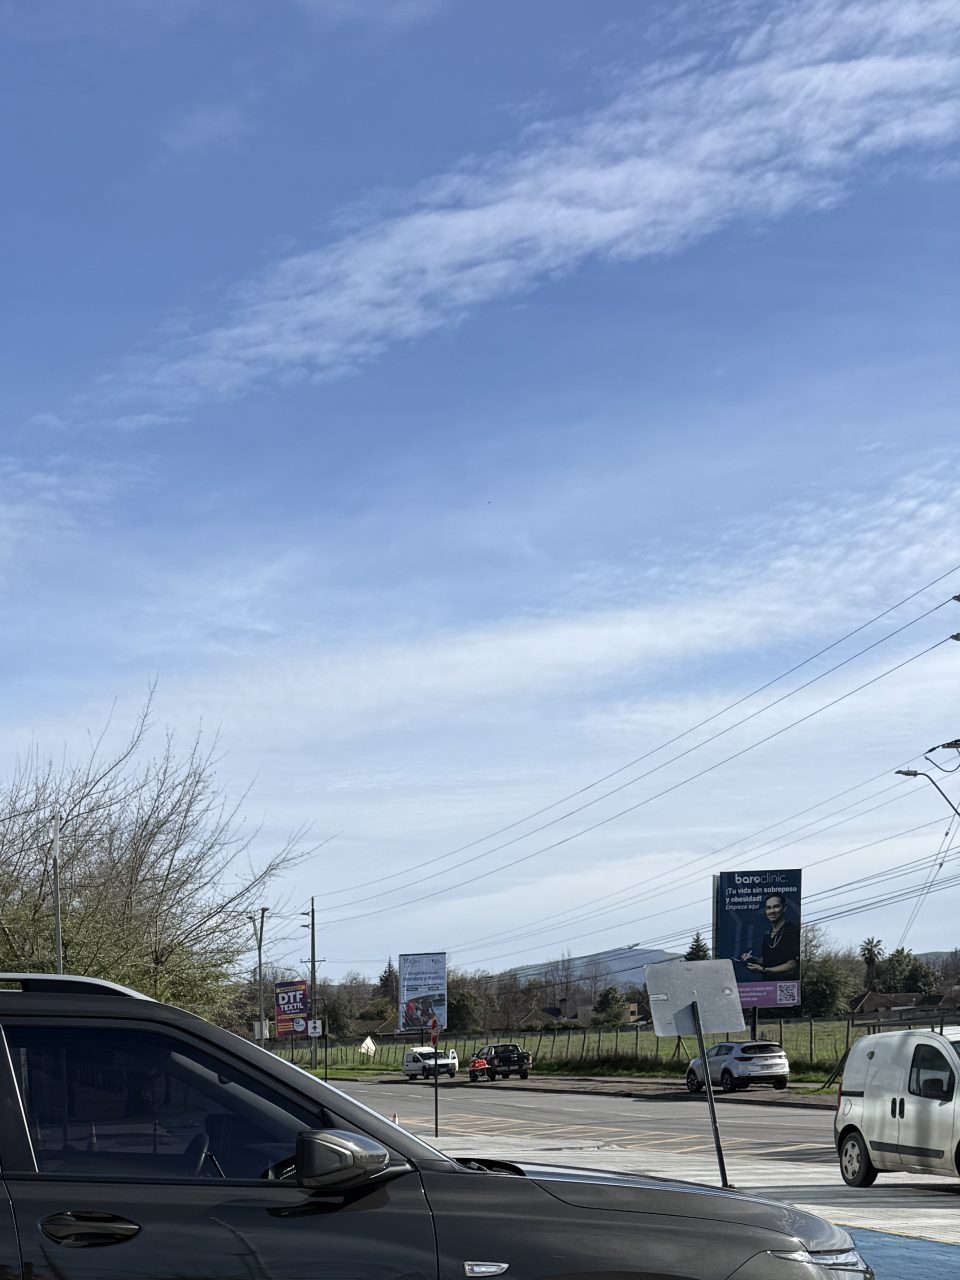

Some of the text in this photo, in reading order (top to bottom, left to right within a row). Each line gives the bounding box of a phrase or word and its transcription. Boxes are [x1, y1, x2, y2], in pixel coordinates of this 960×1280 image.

[738, 886, 751, 894] vida
[763, 886, 798, 894] sobrepeso
[278, 991, 303, 1005] DTF
[280, 1002, 304, 1012] TEXTIL
